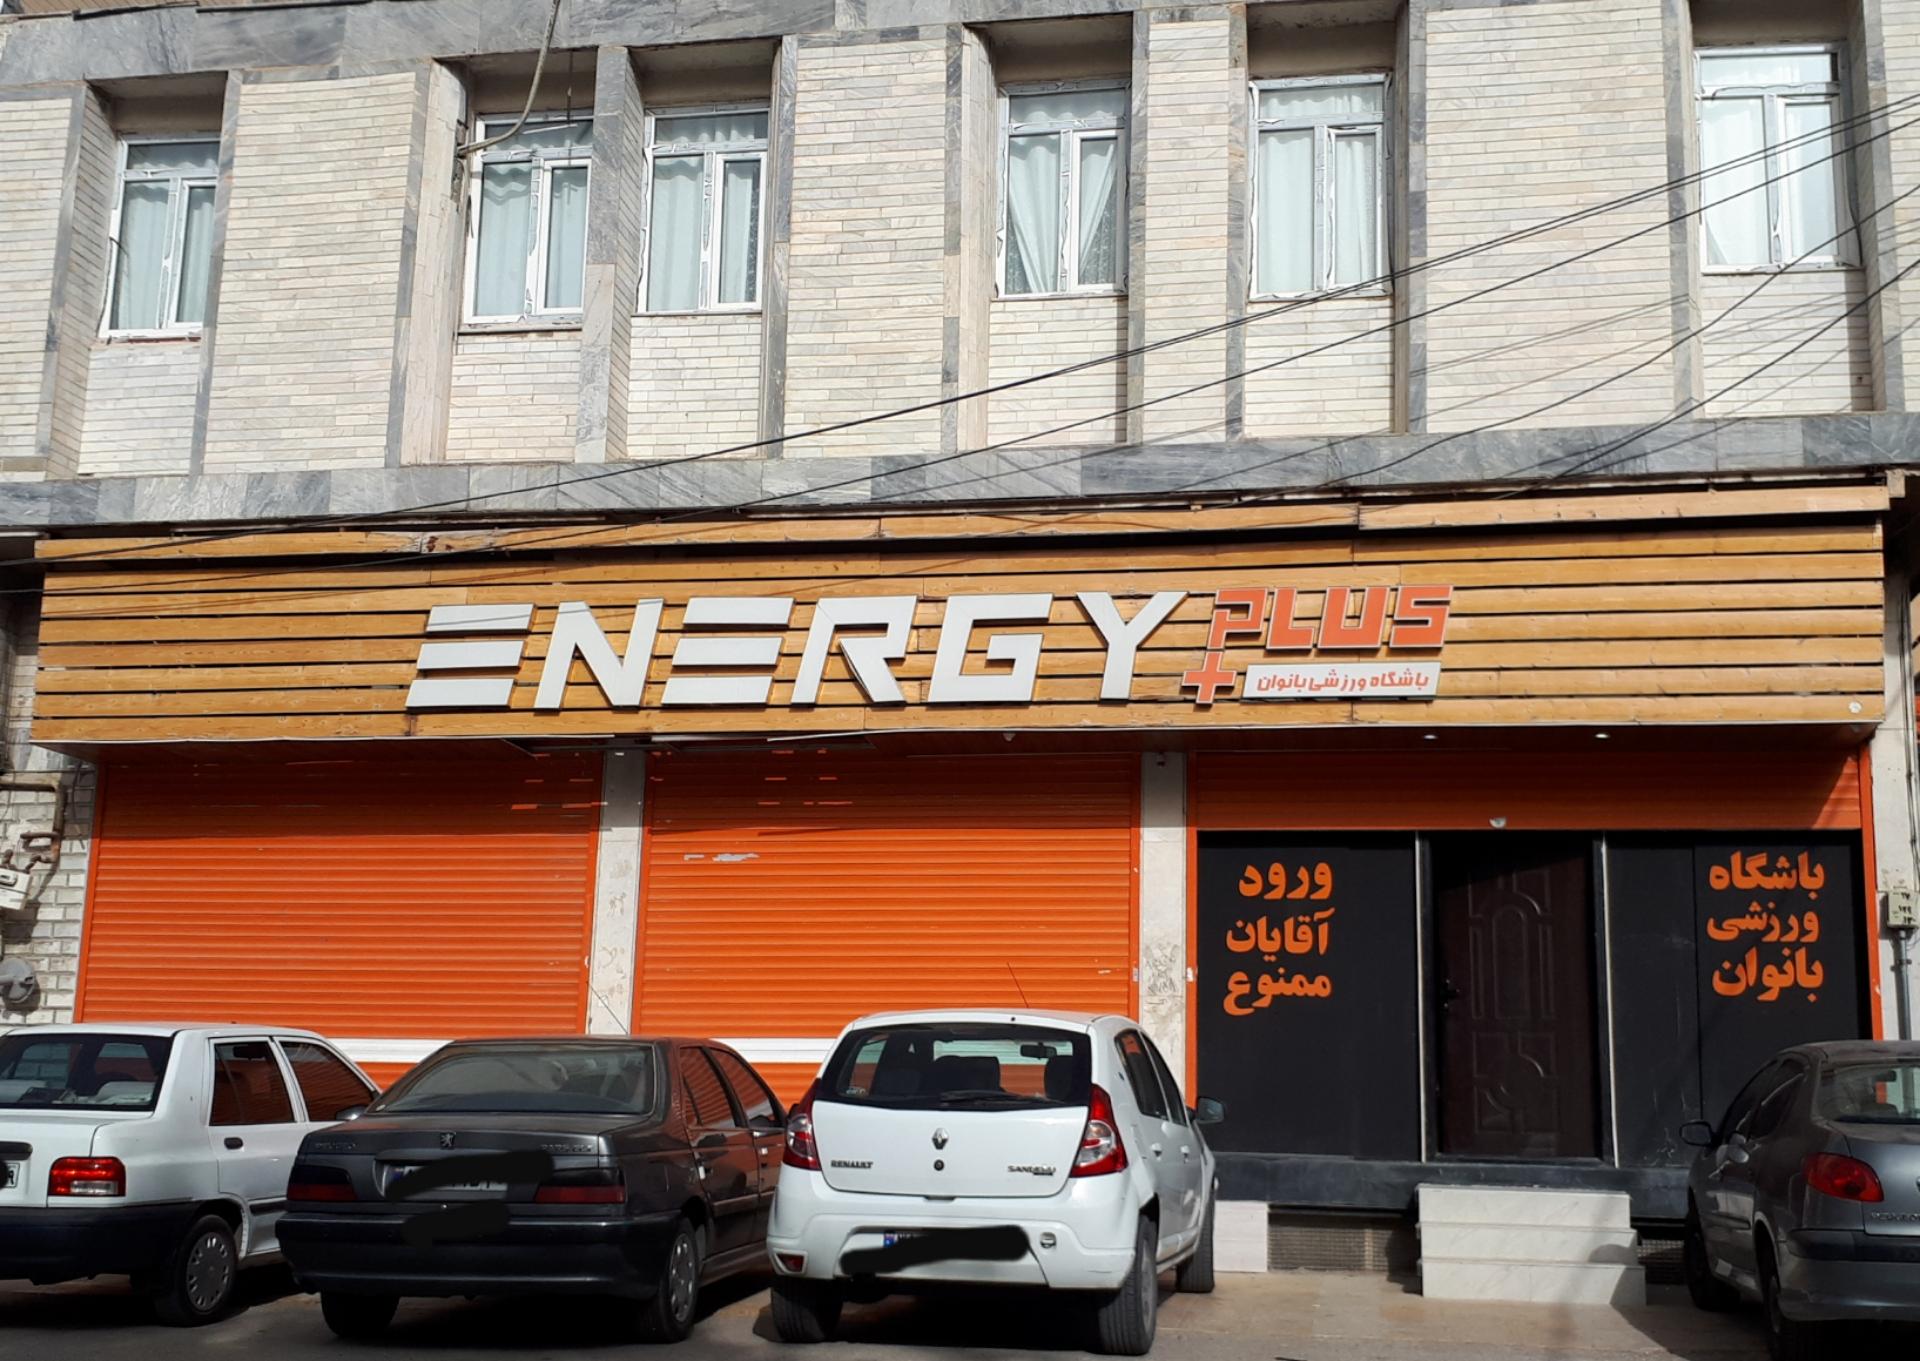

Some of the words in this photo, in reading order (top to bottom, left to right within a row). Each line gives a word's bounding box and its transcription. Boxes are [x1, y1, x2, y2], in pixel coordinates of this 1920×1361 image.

[1206, 584, 1453, 650] PLUS
[404, 591, 1190, 709] ENERGY
[1257, 673, 1307, 693] بانوان
[1308, 669, 1367, 692] ورزشی
[1369, 668, 1429, 691] باشگاه
[1239, 862, 1333, 900] ورود
[1709, 852, 1825, 899] باشگاه
[1226, 908, 1335, 962] آقایان
[1707, 901, 1819, 943] ورزشی
[1223, 967, 1333, 1016] ممنوع
[1712, 947, 1825, 1002] بانوان
